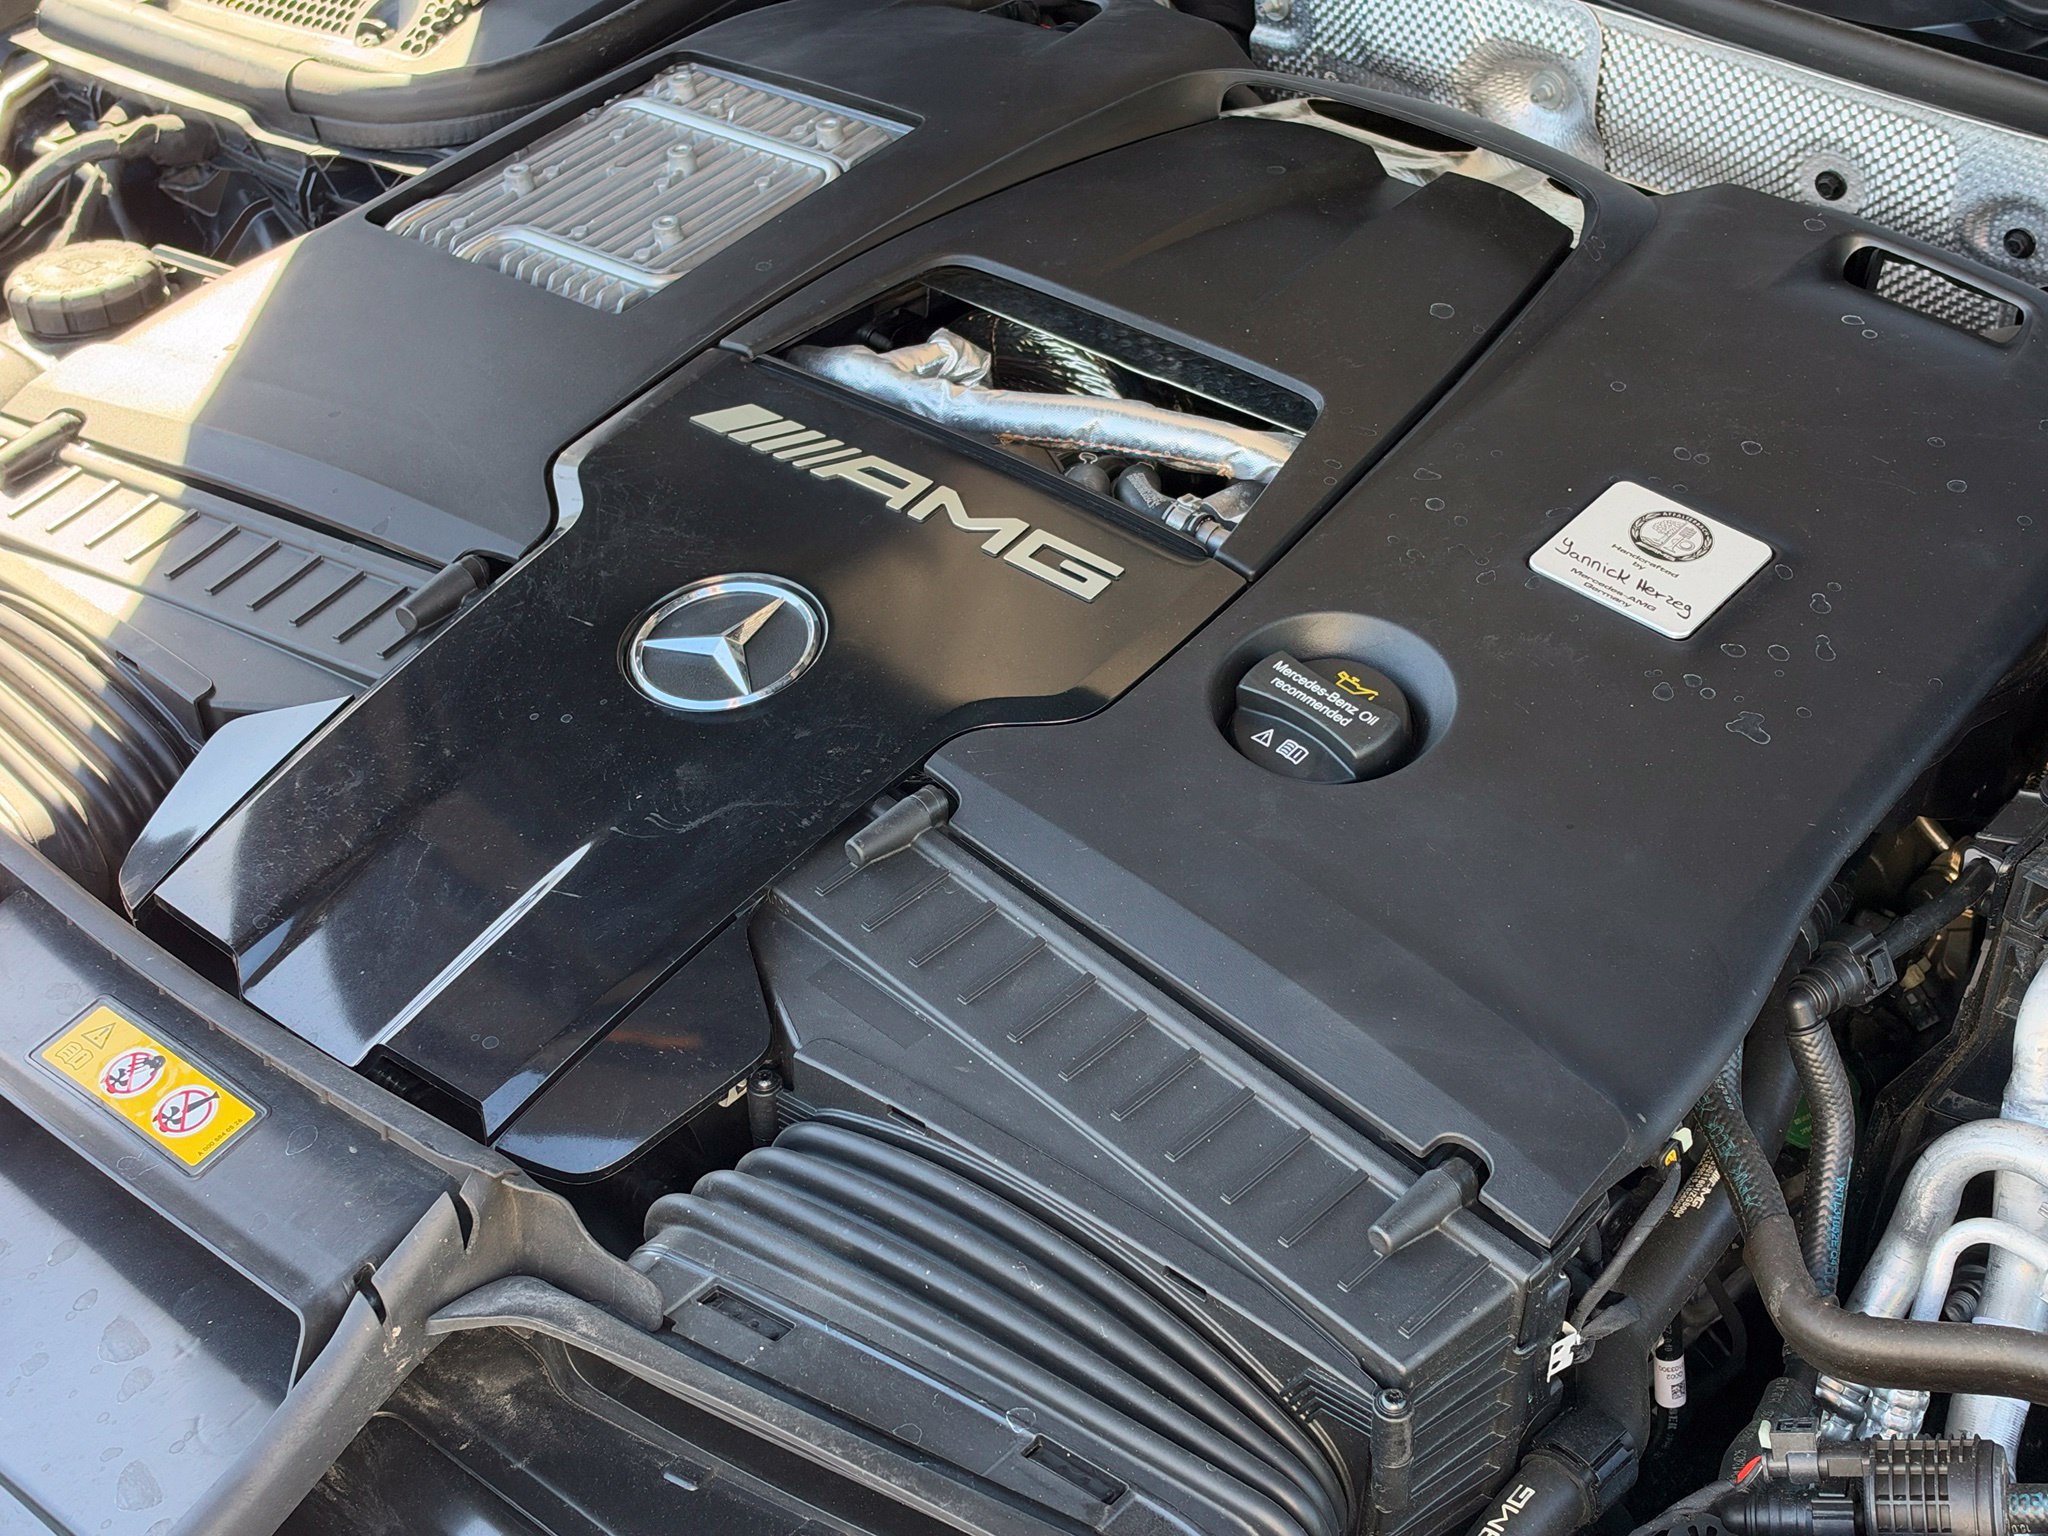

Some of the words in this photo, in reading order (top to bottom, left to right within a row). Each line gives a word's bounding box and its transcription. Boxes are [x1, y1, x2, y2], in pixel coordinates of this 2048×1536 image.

[809, 455, 1125, 602] AMG
[1554, 537, 1631, 585] Yannick
[1611, 543, 1680, 579] Handcrafted
[1632, 561, 1646, 571] by
[1570, 567, 1657, 612] Mercedes-AMG
[1583, 582, 1632, 608] Germany
[1270, 676, 1353, 727] recommended
[1272, 660, 1360, 716] Mercedes-Benz
[1358, 711, 1380, 727] Oil
